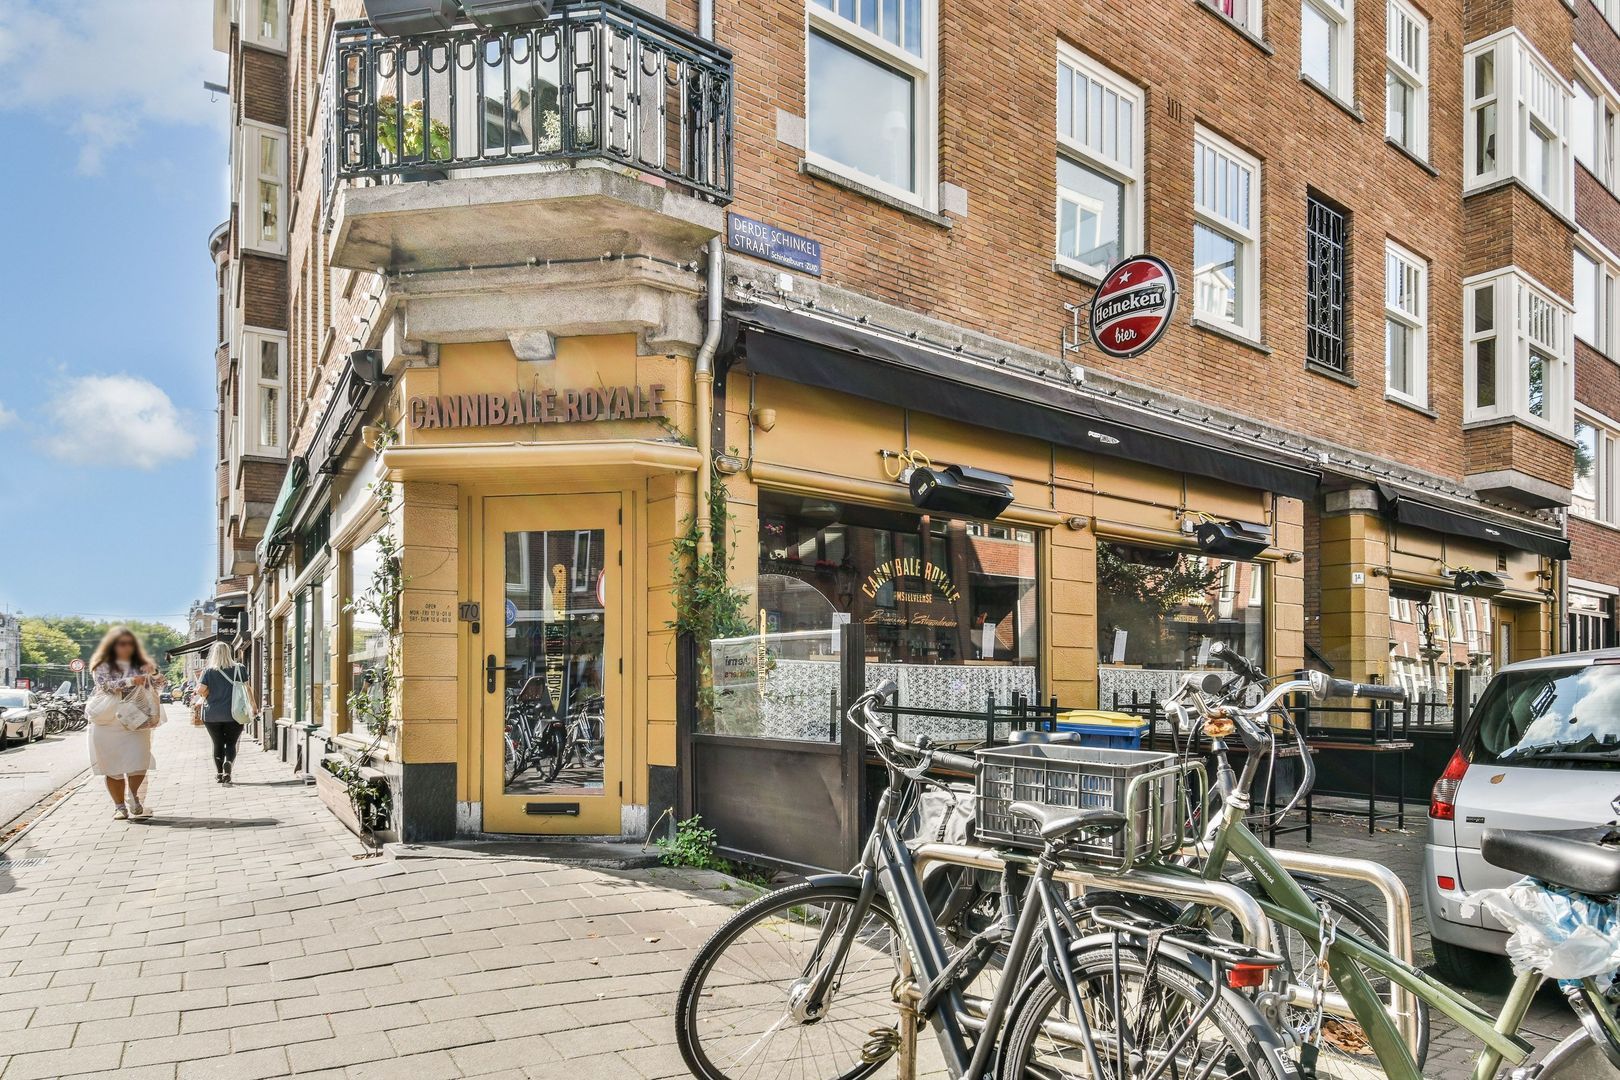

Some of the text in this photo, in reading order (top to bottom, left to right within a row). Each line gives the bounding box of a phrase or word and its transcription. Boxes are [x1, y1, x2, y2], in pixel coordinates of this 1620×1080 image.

[734, 217, 817, 257] DERDE SCHINKEL
[734, 234, 770, 256] STRAAT
[1095, 293, 1161, 323] Heineken
[1115, 327, 1137, 344] bier
[410, 383, 667, 430] CANNIBALE ROYALE
[862, 558, 960, 604] CANNIBALE ROYALE
[460, 604, 478, 618] 170
[548, 674, 561, 701] ROYALE
[887, 890, 921, 976] BATAVUS
